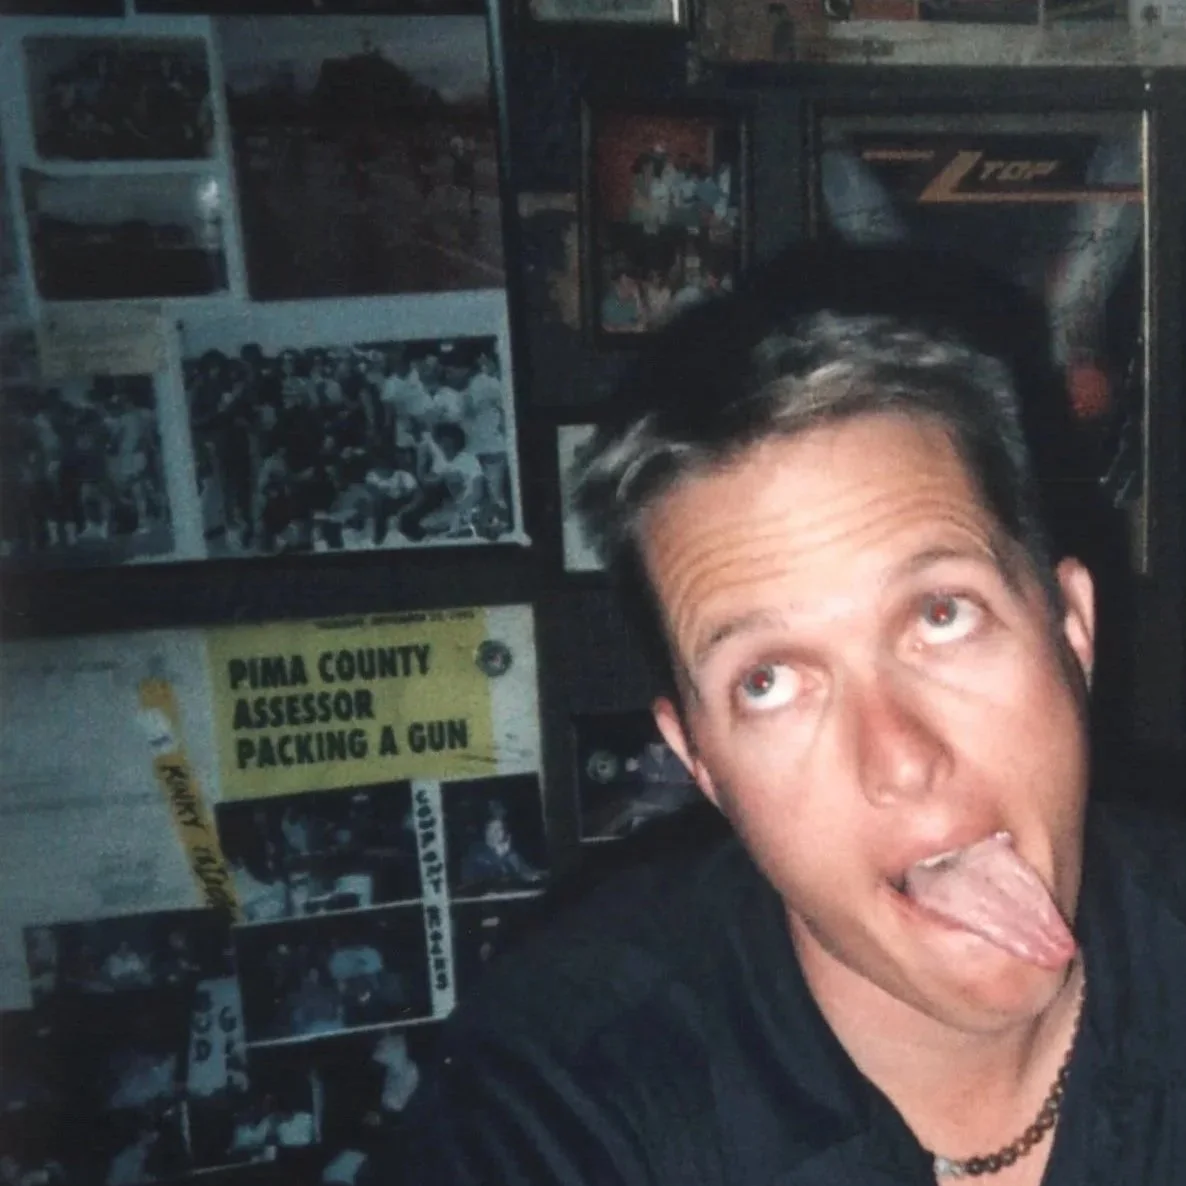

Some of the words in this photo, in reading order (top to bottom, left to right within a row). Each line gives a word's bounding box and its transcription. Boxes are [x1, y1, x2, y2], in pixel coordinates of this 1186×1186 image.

[979, 160, 1059, 181] TOP
[228, 655, 309, 690] PIMA
[317, 643, 431, 683] COUNTY
[232, 688, 376, 731] ASSESSOR
[235, 727, 369, 769] PACKING
[378, 724, 400, 756] A
[407, 718, 468, 754] GUN
